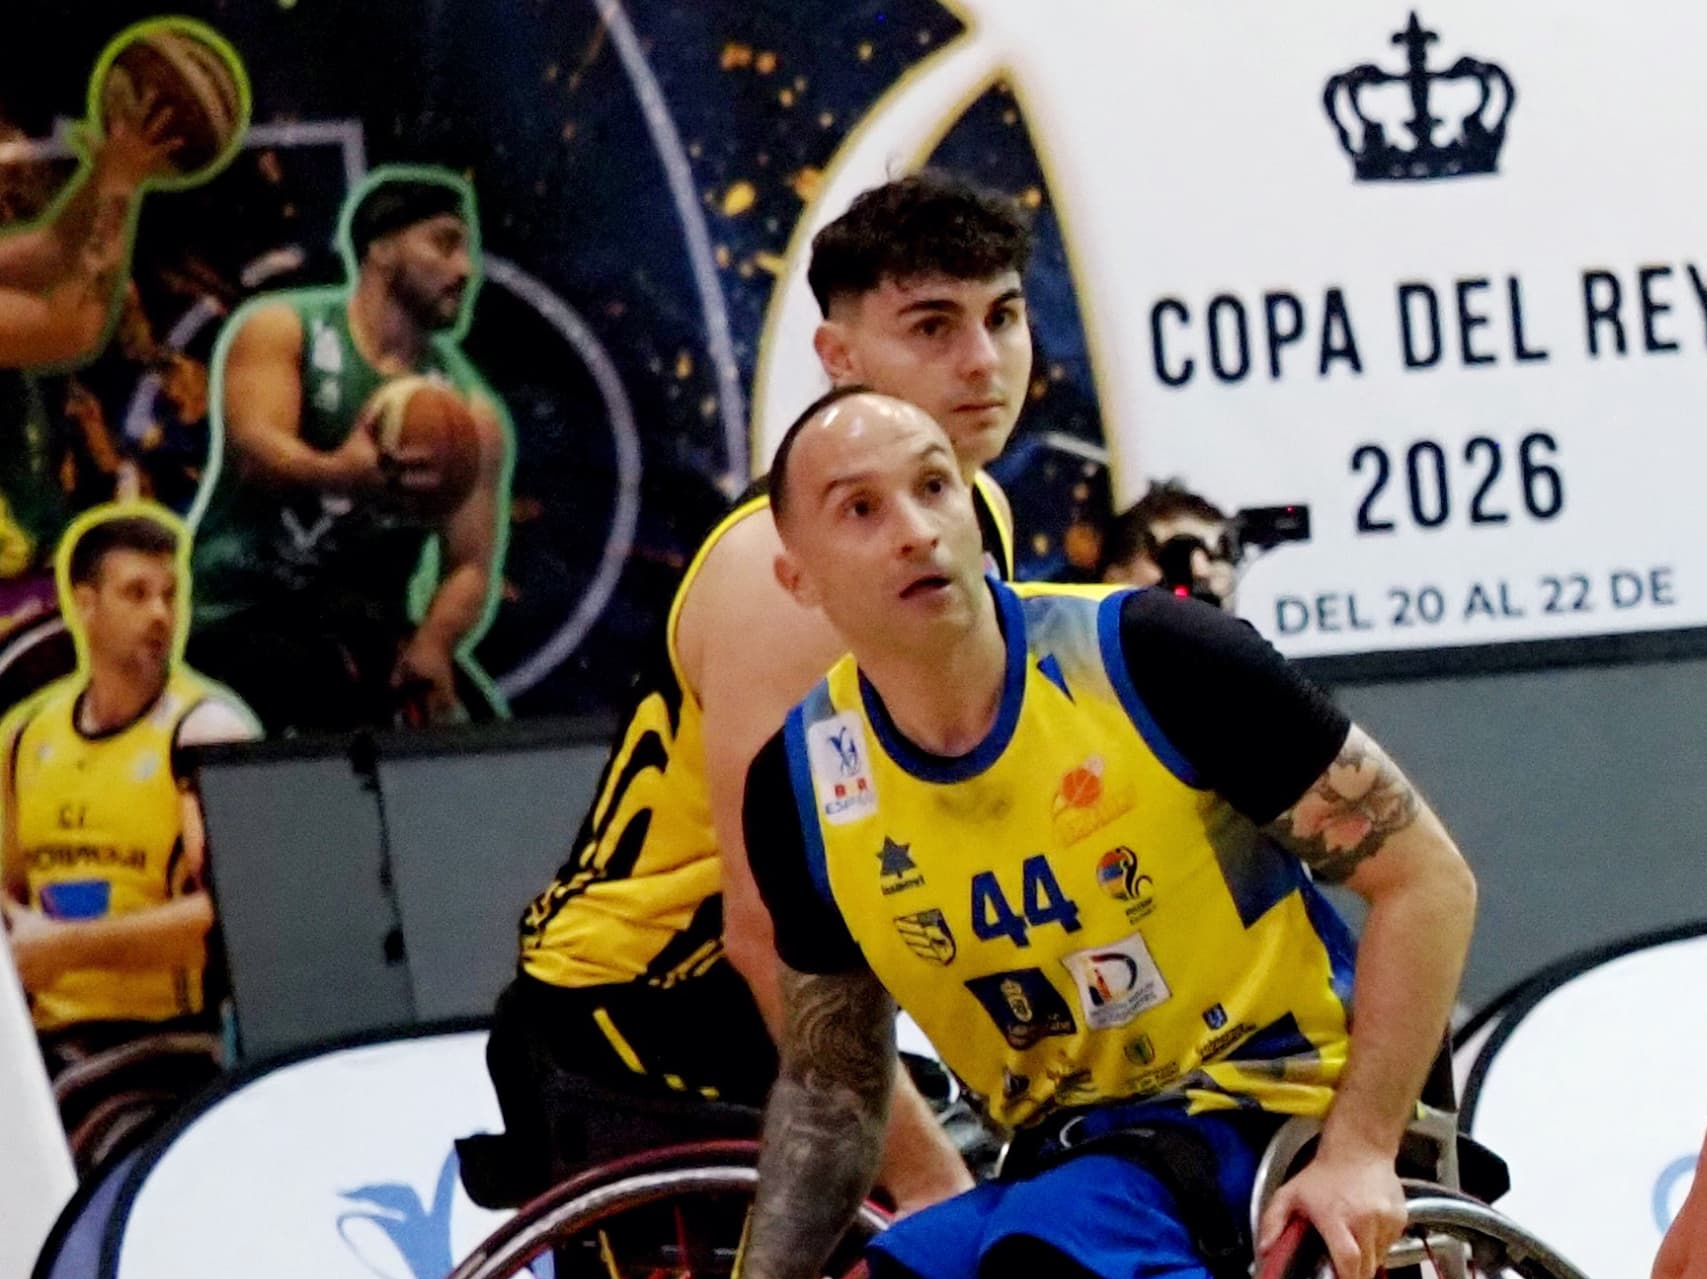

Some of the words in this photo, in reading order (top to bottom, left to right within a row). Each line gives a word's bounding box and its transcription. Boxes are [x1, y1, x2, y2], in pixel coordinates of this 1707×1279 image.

[1150, 288, 1362, 390] COPA
[1398, 276, 1548, 370] DEL
[1350, 432, 1566, 534] 2026
[1275, 586, 1374, 636] DEL
[1386, 576, 1446, 626] 20
[1464, 568, 1524, 620] AL
[1540, 566, 1594, 610] 22
[1609, 566, 1678, 608] DE
[968, 854, 1082, 948] 44
